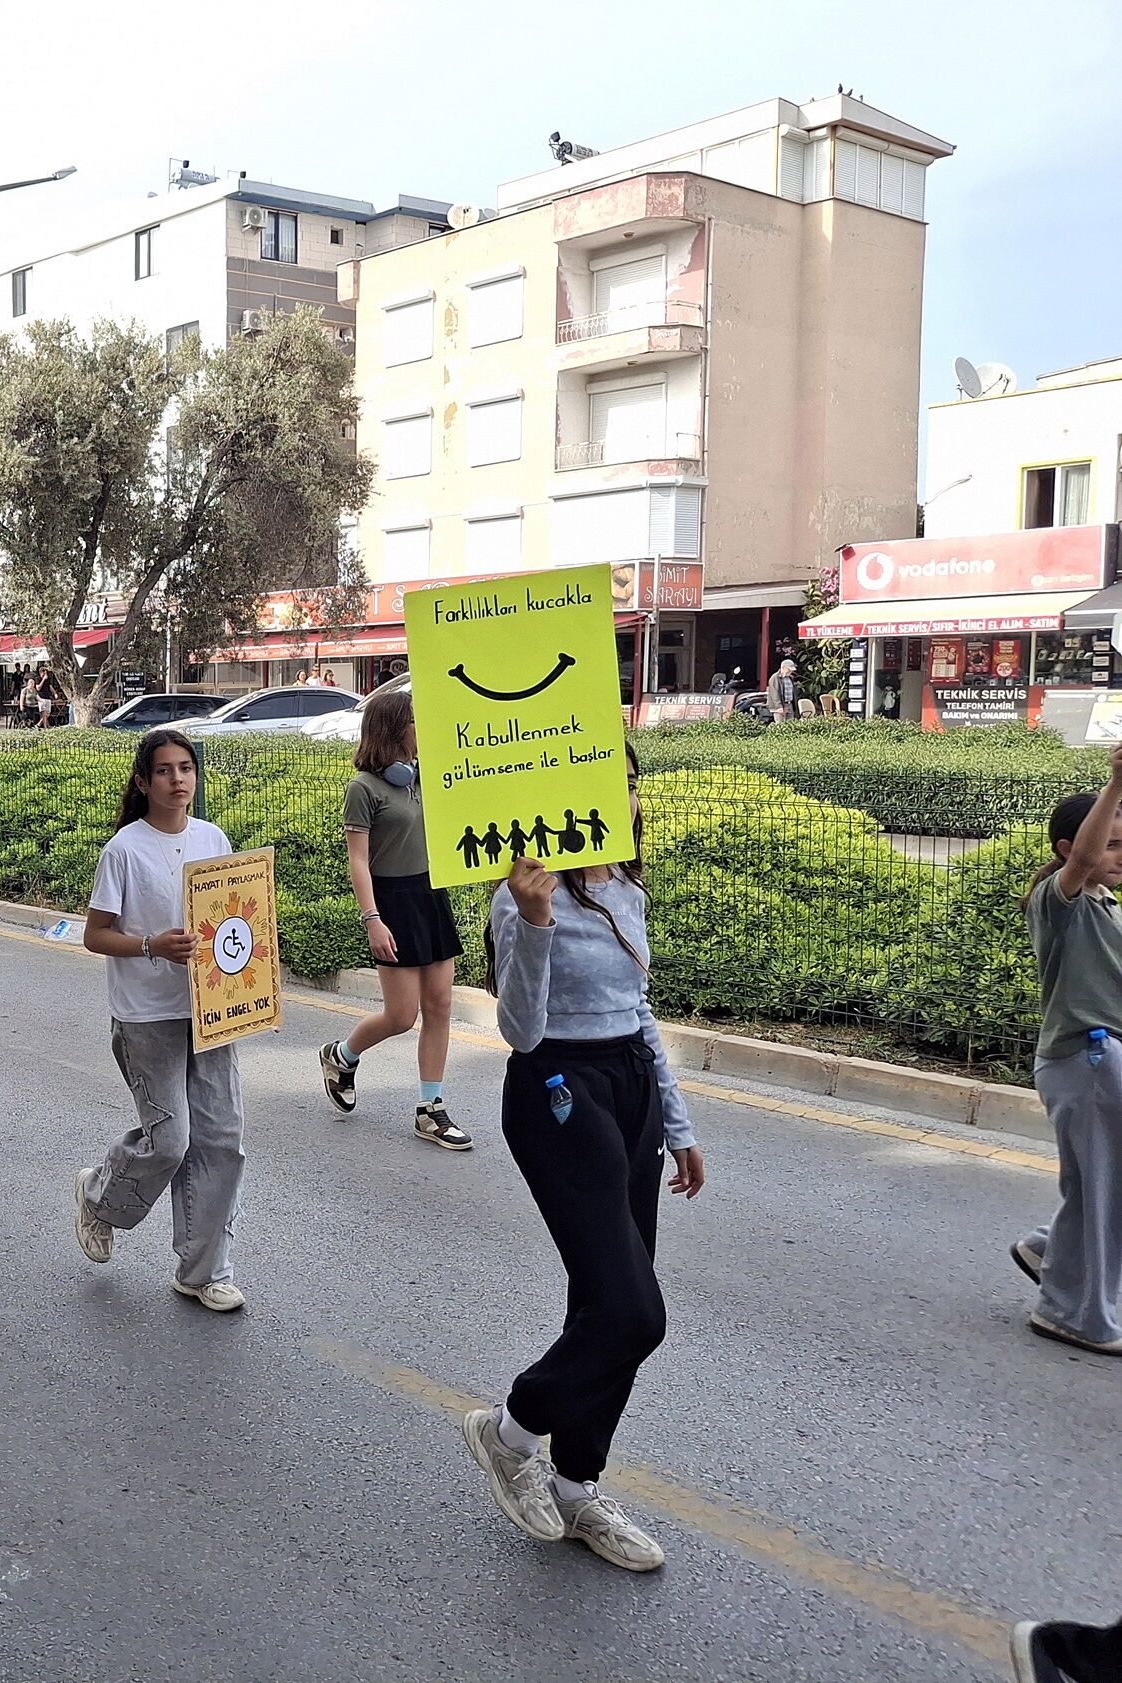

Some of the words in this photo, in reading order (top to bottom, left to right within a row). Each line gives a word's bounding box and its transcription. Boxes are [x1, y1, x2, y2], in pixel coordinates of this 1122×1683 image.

[898, 557, 996, 578] vodafone
[434, 593, 518, 625] Farklılıkları
[526, 583, 593, 613] kucakla
[817, 625, 854, 636] YÜKLEME
[654, 696, 687, 705] TEKNİK
[936, 688, 979, 700] TEKNİK
[981, 688, 1027, 700] SERVİS
[942, 711, 969, 719] BAKIM
[981, 711, 1018, 719] ONARIMI
[946, 702, 983, 710] TELEFON
[985, 701, 1014, 710] TAMİRİ
[455, 714, 584, 749] Kabullenmek
[442, 758, 534, 789] gülümseme
[540, 751, 560, 769] ile
[569, 745, 615, 765] başlar
[193, 879, 224, 893] HAYATI
[227, 871, 266, 886] PAYLAŞMAK
[202, 1008, 221, 1030] İÇİN
[226, 1003, 252, 1019] ENGEL
[253, 996, 270, 1011] YOK
